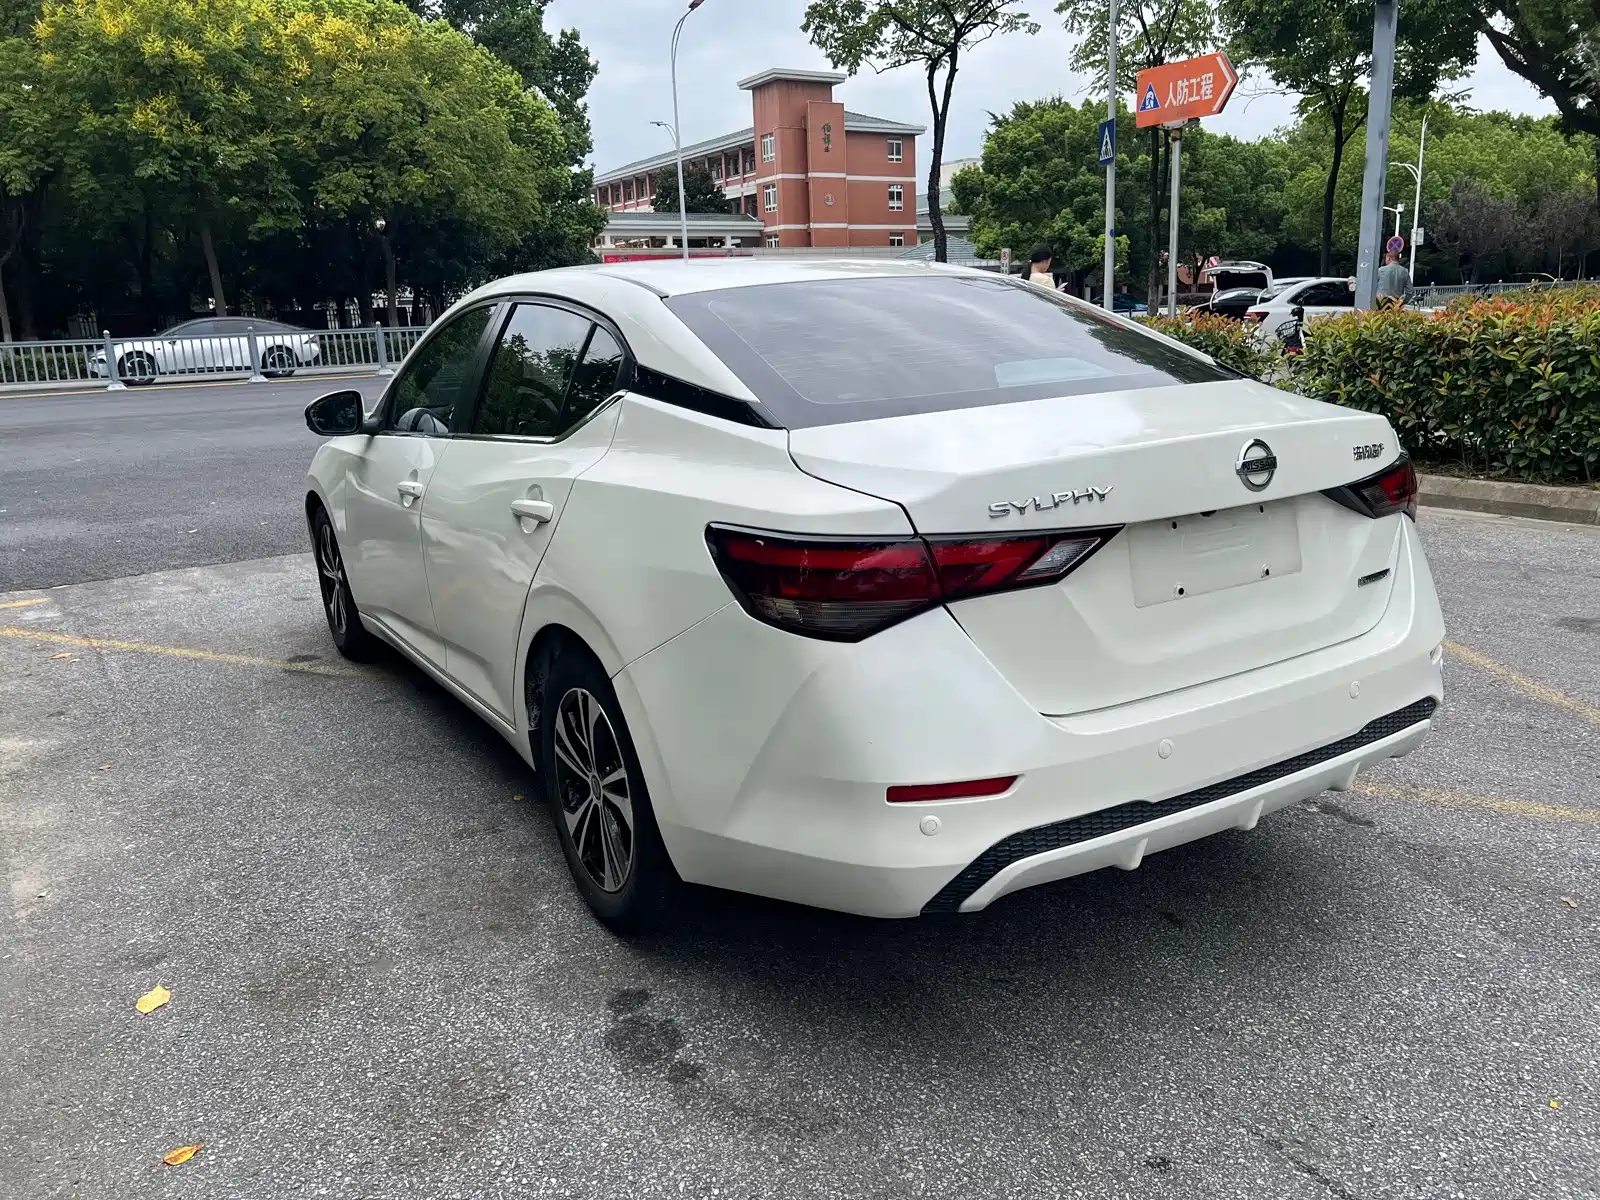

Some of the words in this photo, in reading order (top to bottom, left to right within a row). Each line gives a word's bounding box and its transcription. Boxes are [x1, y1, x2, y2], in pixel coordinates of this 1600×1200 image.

[1164, 72, 1214, 108] 人防工程
[1240, 457, 1276, 472] NISSAN
[988, 486, 1113, 518] SYLPHY
